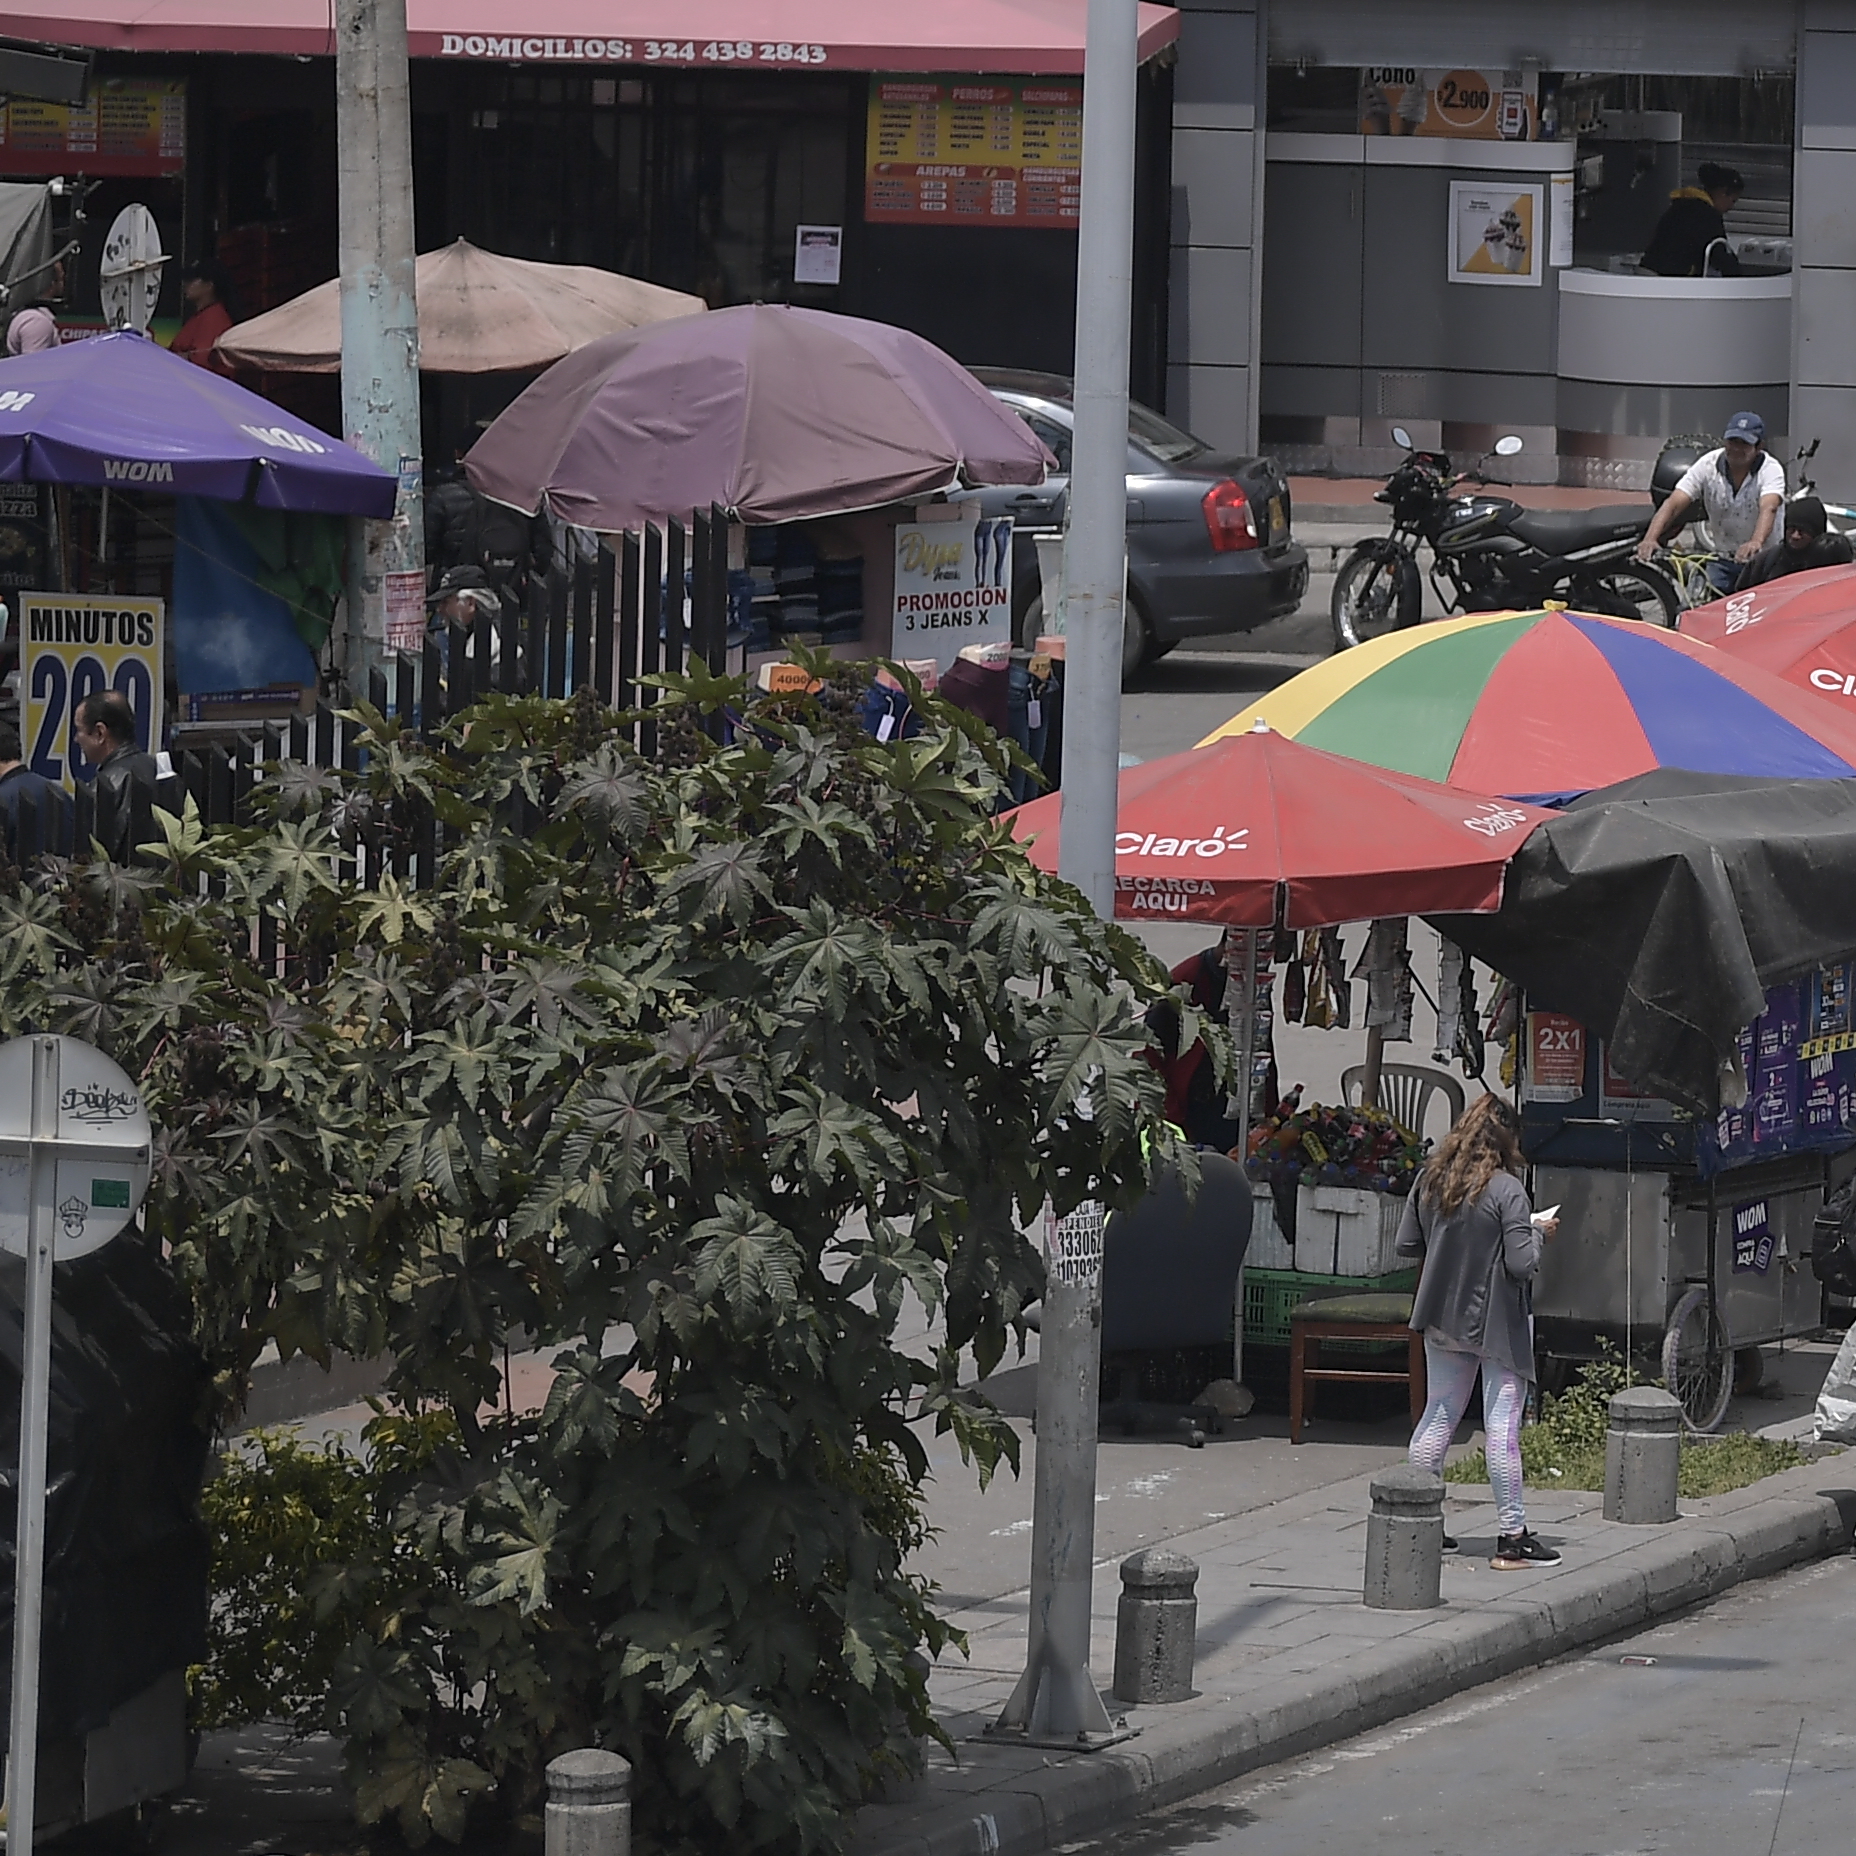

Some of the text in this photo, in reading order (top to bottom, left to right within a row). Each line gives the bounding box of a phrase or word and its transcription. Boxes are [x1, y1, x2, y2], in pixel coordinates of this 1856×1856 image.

[440, 34, 828, 63] DOMICILIOS: 324 438 2843
[952, 88, 995, 100] PERROS
[916, 166, 967, 178] AREPAS
[103, 459, 174, 483] WOM
[897, 583, 1007, 613] PROMOCIÓN
[905, 608, 990, 631] 3 JEANS X
[1114, 827, 1240, 859] Claro
[1131, 892, 1188, 913] AQUI
[1539, 1027, 1583, 1051] 2x1
[1808, 1052, 1834, 1079] WOM
[1736, 1200, 1767, 1235] WOM
